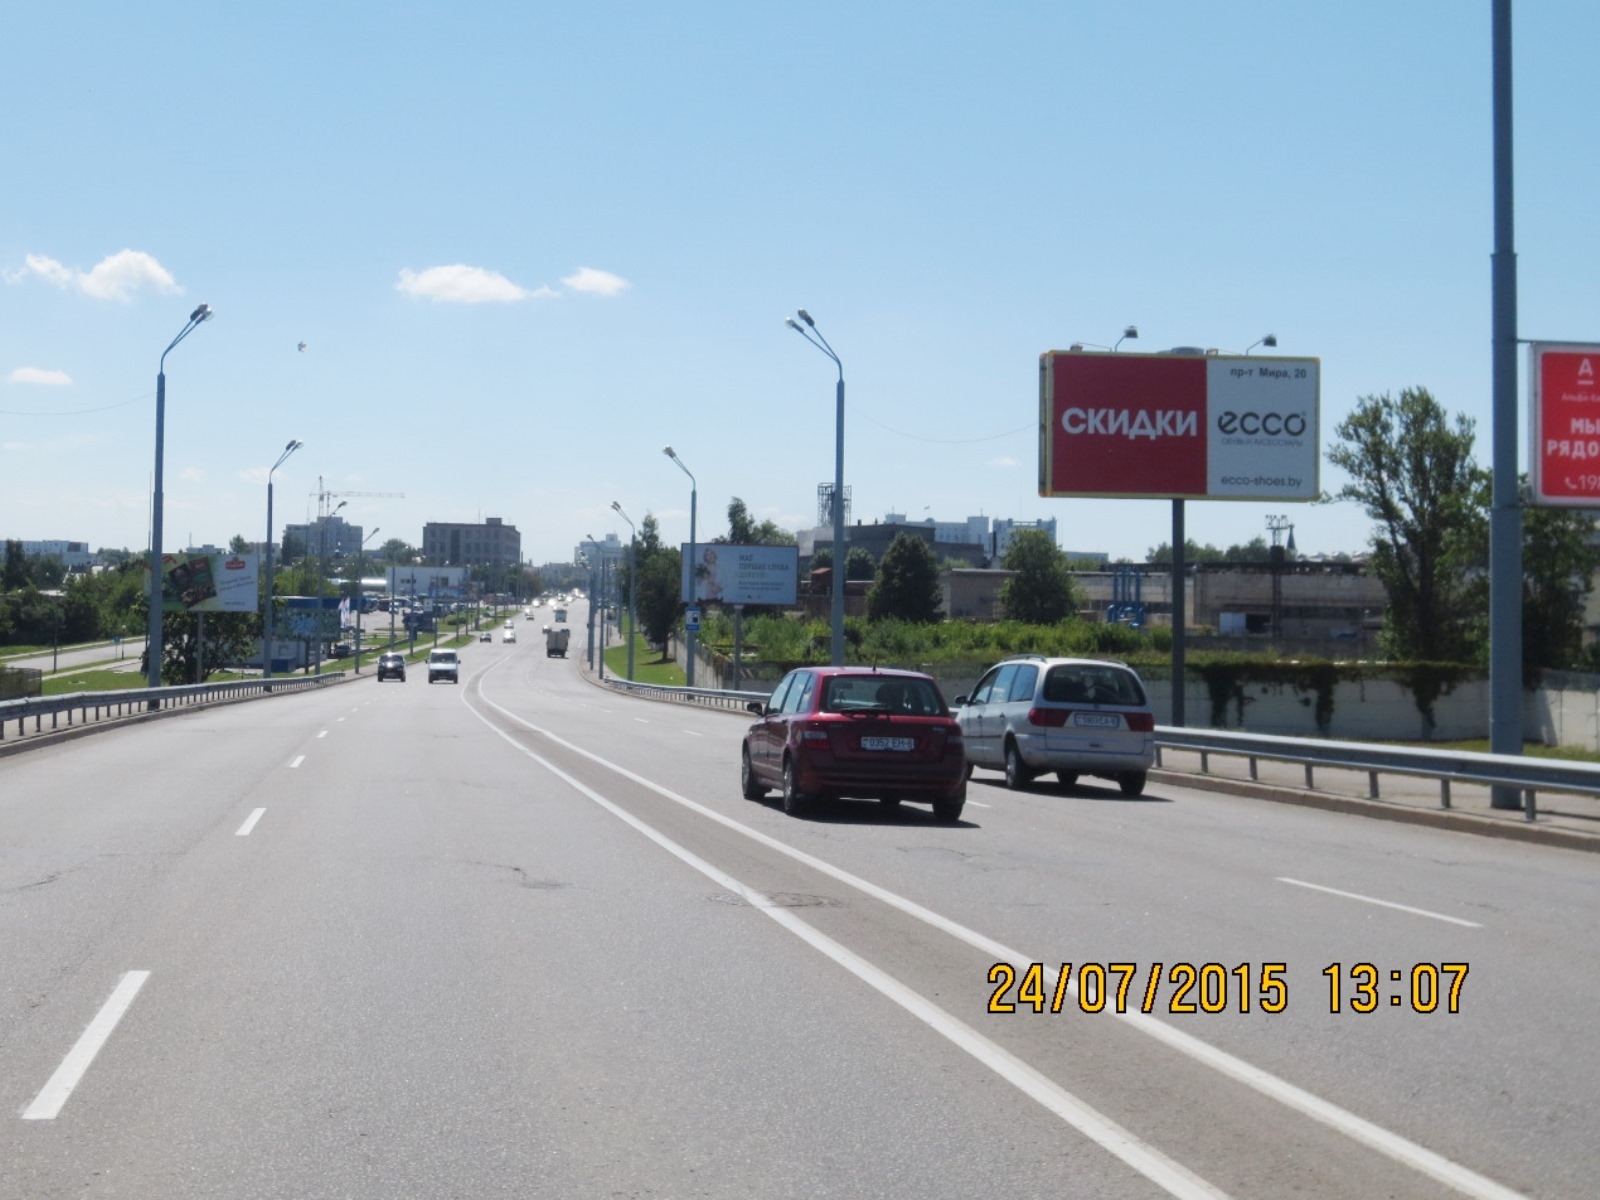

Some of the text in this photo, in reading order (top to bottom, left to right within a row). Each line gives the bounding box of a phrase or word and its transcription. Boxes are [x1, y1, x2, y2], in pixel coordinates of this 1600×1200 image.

[1230, 368, 1307, 379] пр-т Мира, 20
[1061, 408, 1198, 440] СКИДКИ
[1217, 411, 1306, 436] ecco
[1220, 476, 1303, 488] ecco-shoes.by
